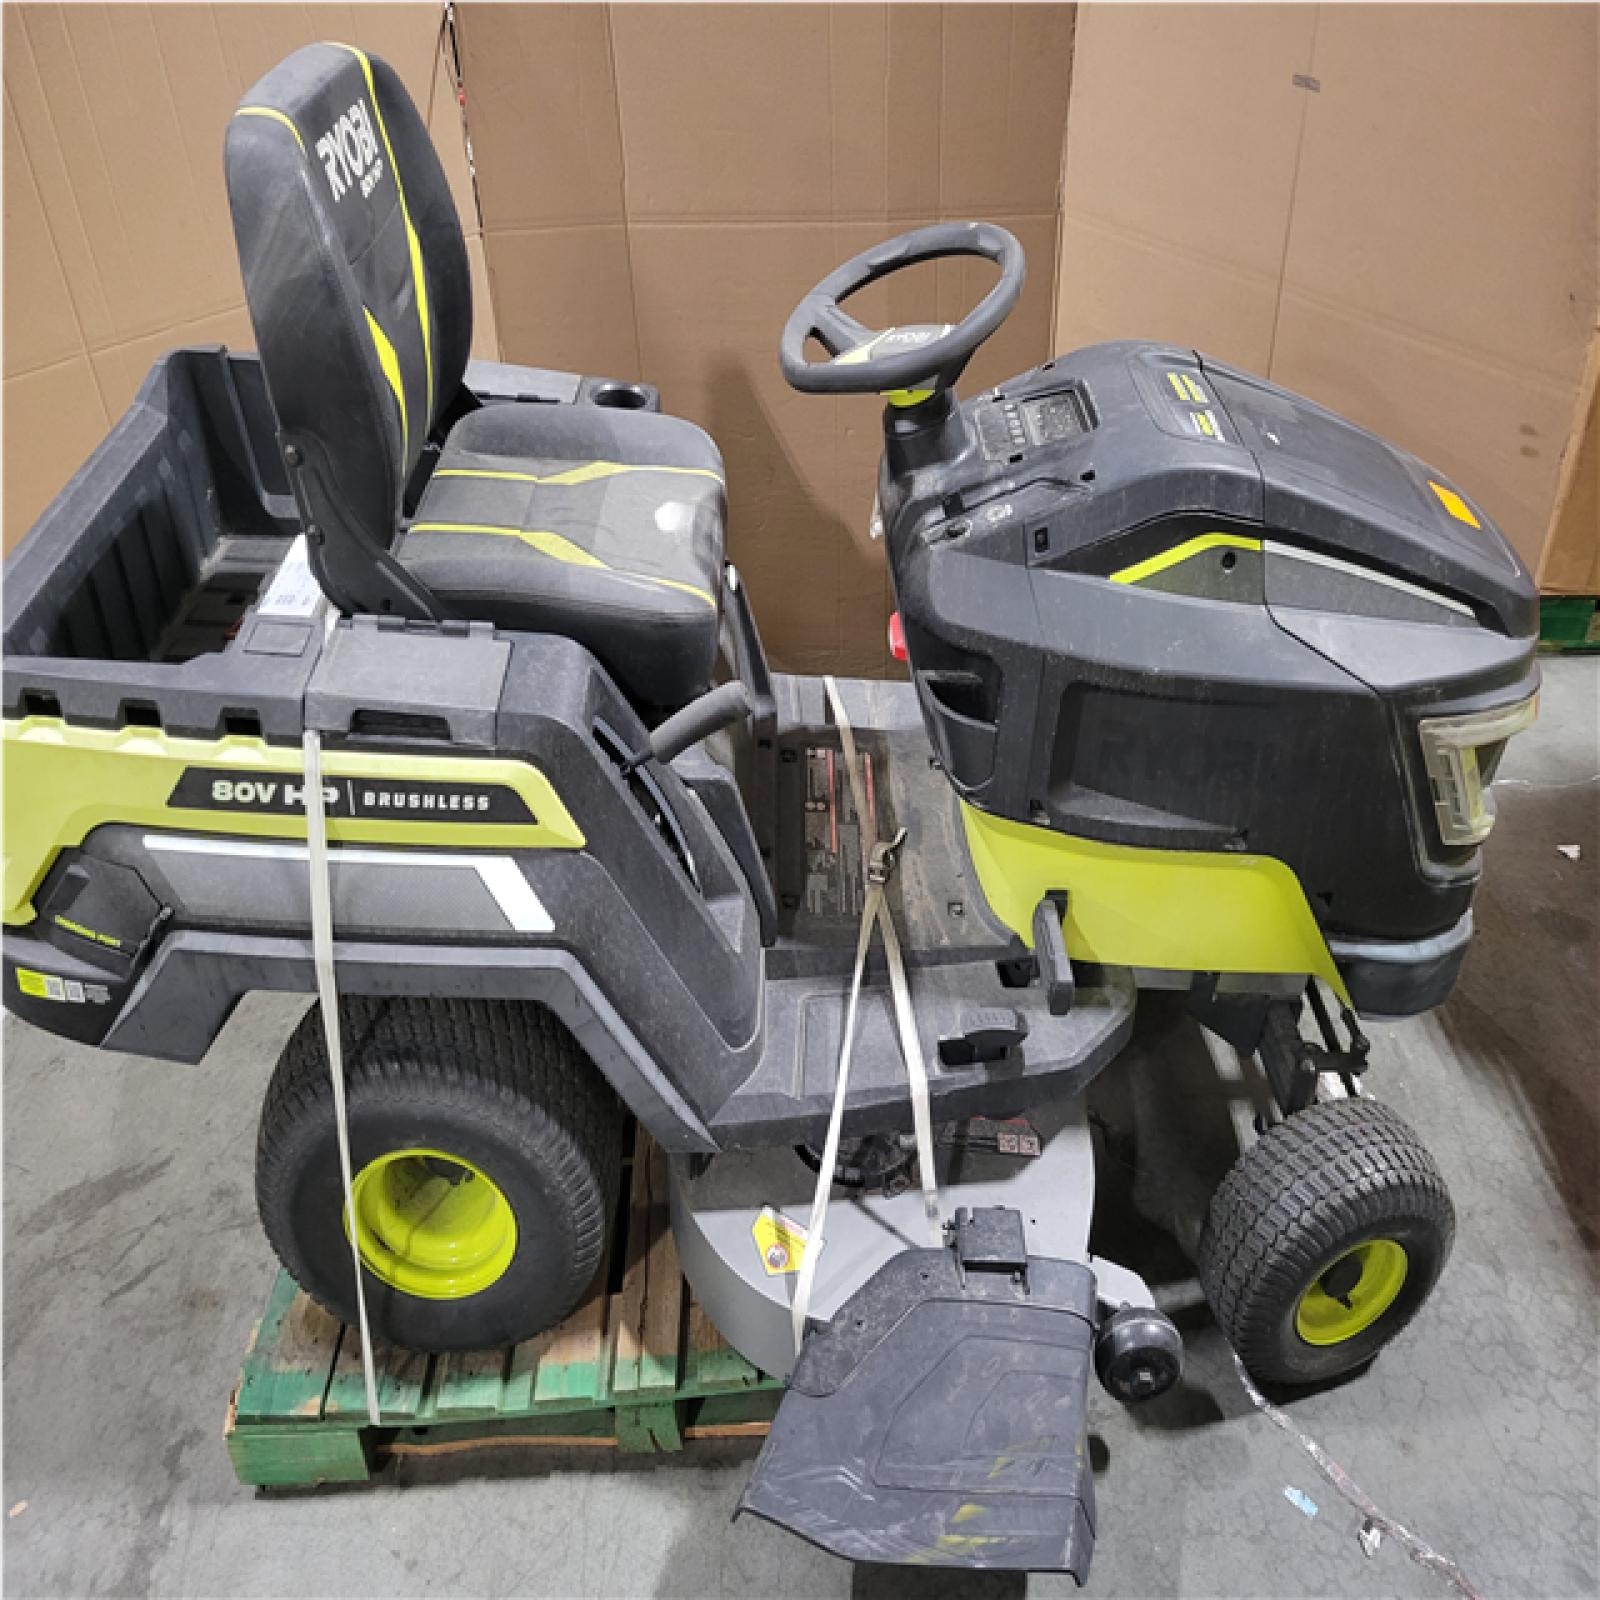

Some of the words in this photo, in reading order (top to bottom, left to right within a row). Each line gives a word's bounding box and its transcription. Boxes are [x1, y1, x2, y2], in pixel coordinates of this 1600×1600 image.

[315, 97, 378, 202] RYOBI
[212, 779, 277, 804] 80V
[362, 790, 490, 811] BRUSHLESS
